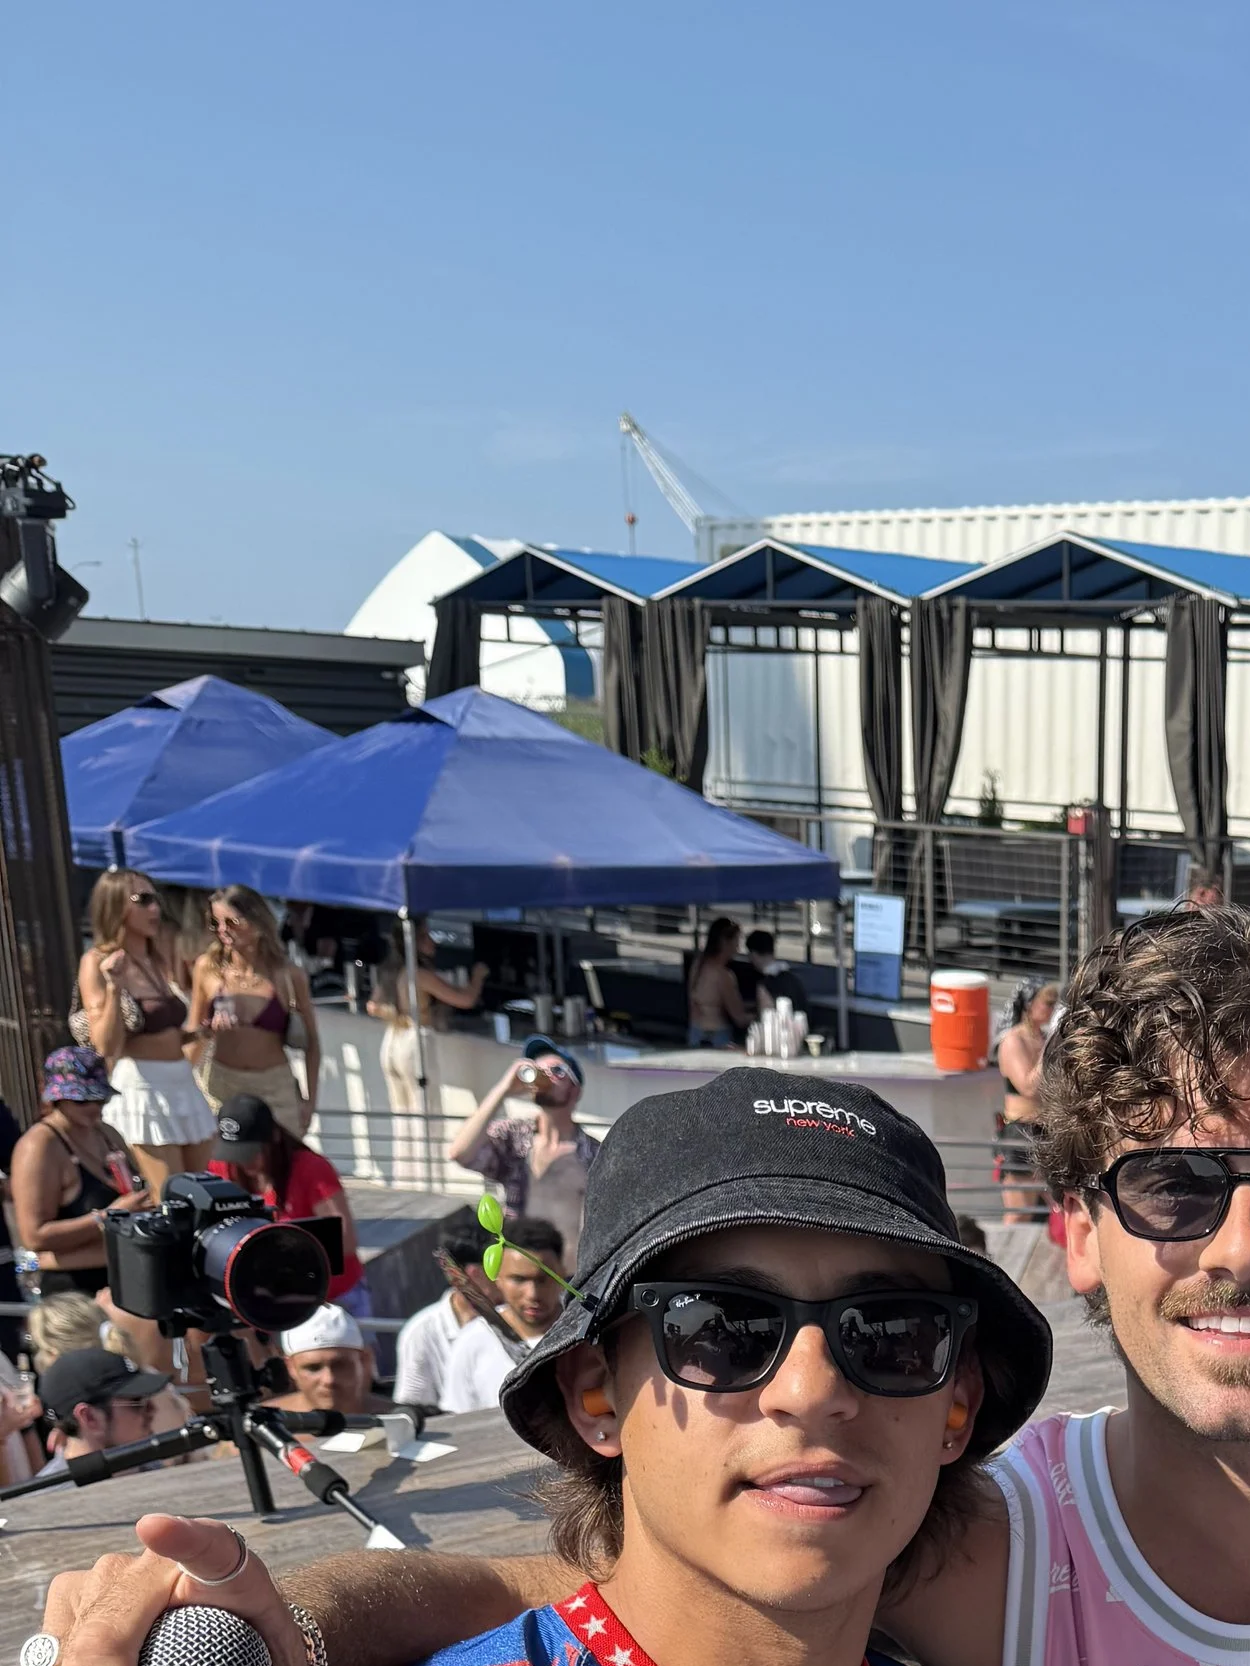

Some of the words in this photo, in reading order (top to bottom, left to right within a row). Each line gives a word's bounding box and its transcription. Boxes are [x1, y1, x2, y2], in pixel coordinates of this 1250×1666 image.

[753, 1097, 877, 1136] supreme
[786, 1116, 820, 1128] new
[822, 1120, 856, 1138] york
